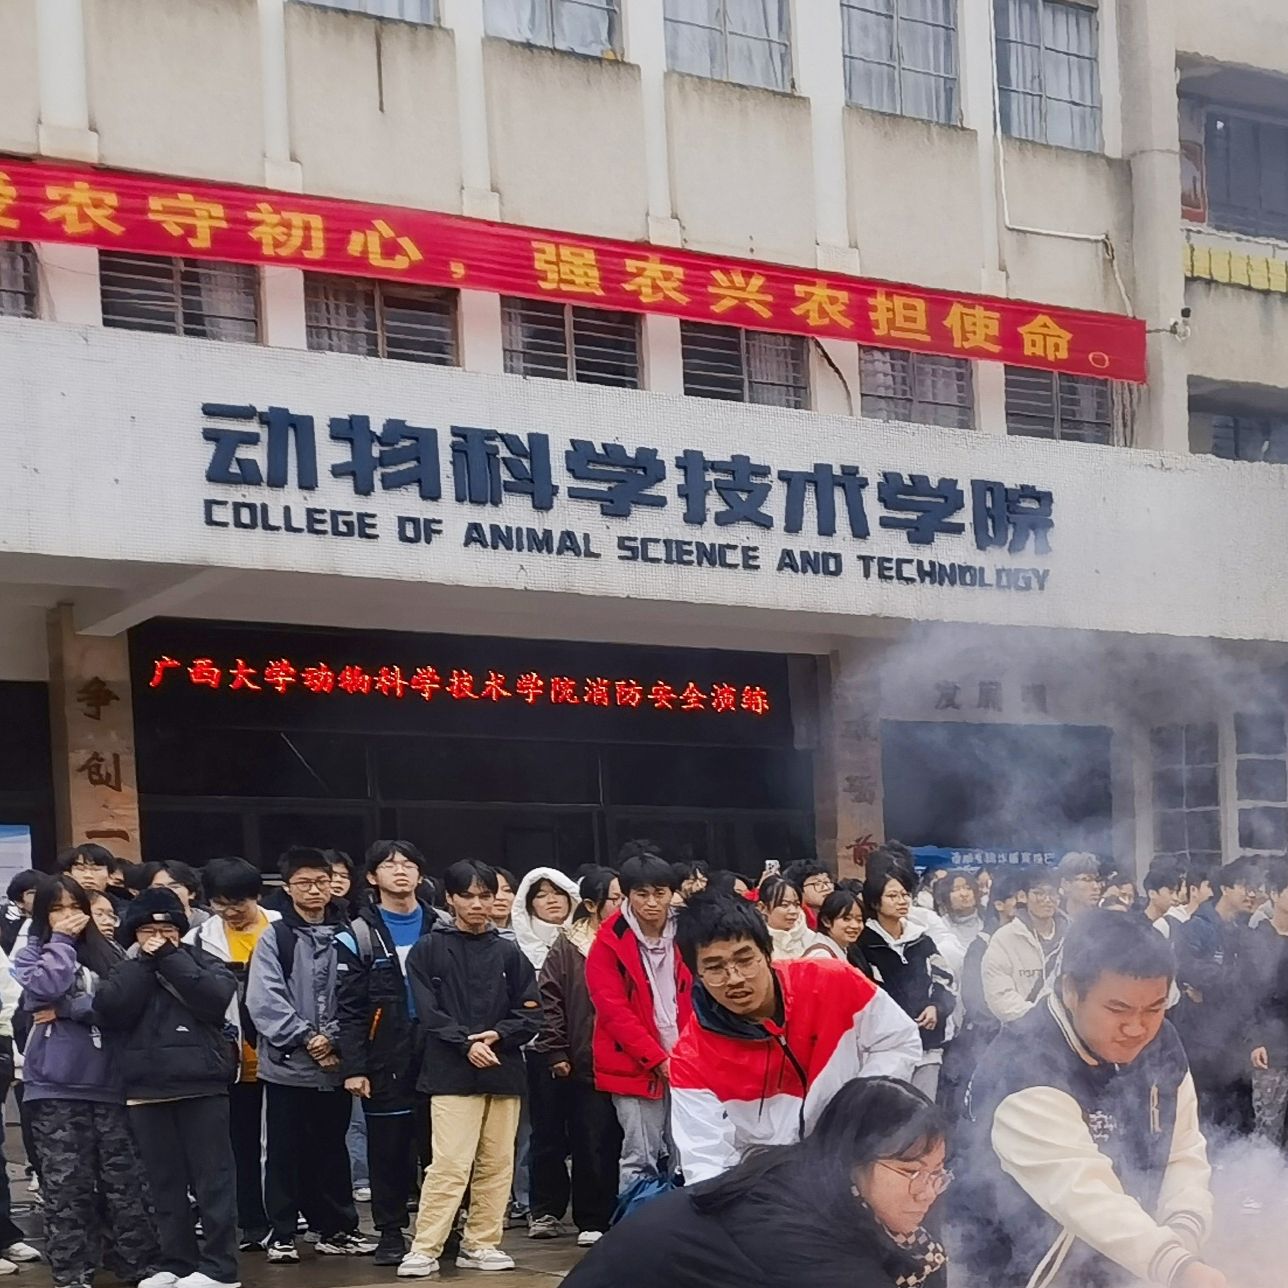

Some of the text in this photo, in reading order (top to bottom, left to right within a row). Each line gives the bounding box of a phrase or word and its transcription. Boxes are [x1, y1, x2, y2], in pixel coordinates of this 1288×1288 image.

[0, 170, 1111, 369] 农守初心，强农兴农担使命。
[200, 402, 1055, 556] 动物科学技术学院
[203, 497, 1050, 592] COLLEGE OF ANIMAL SCIENCE AND TECHNOLOGY
[149, 656, 770, 715] 广西大学动物科学技术学院消防安全演练
